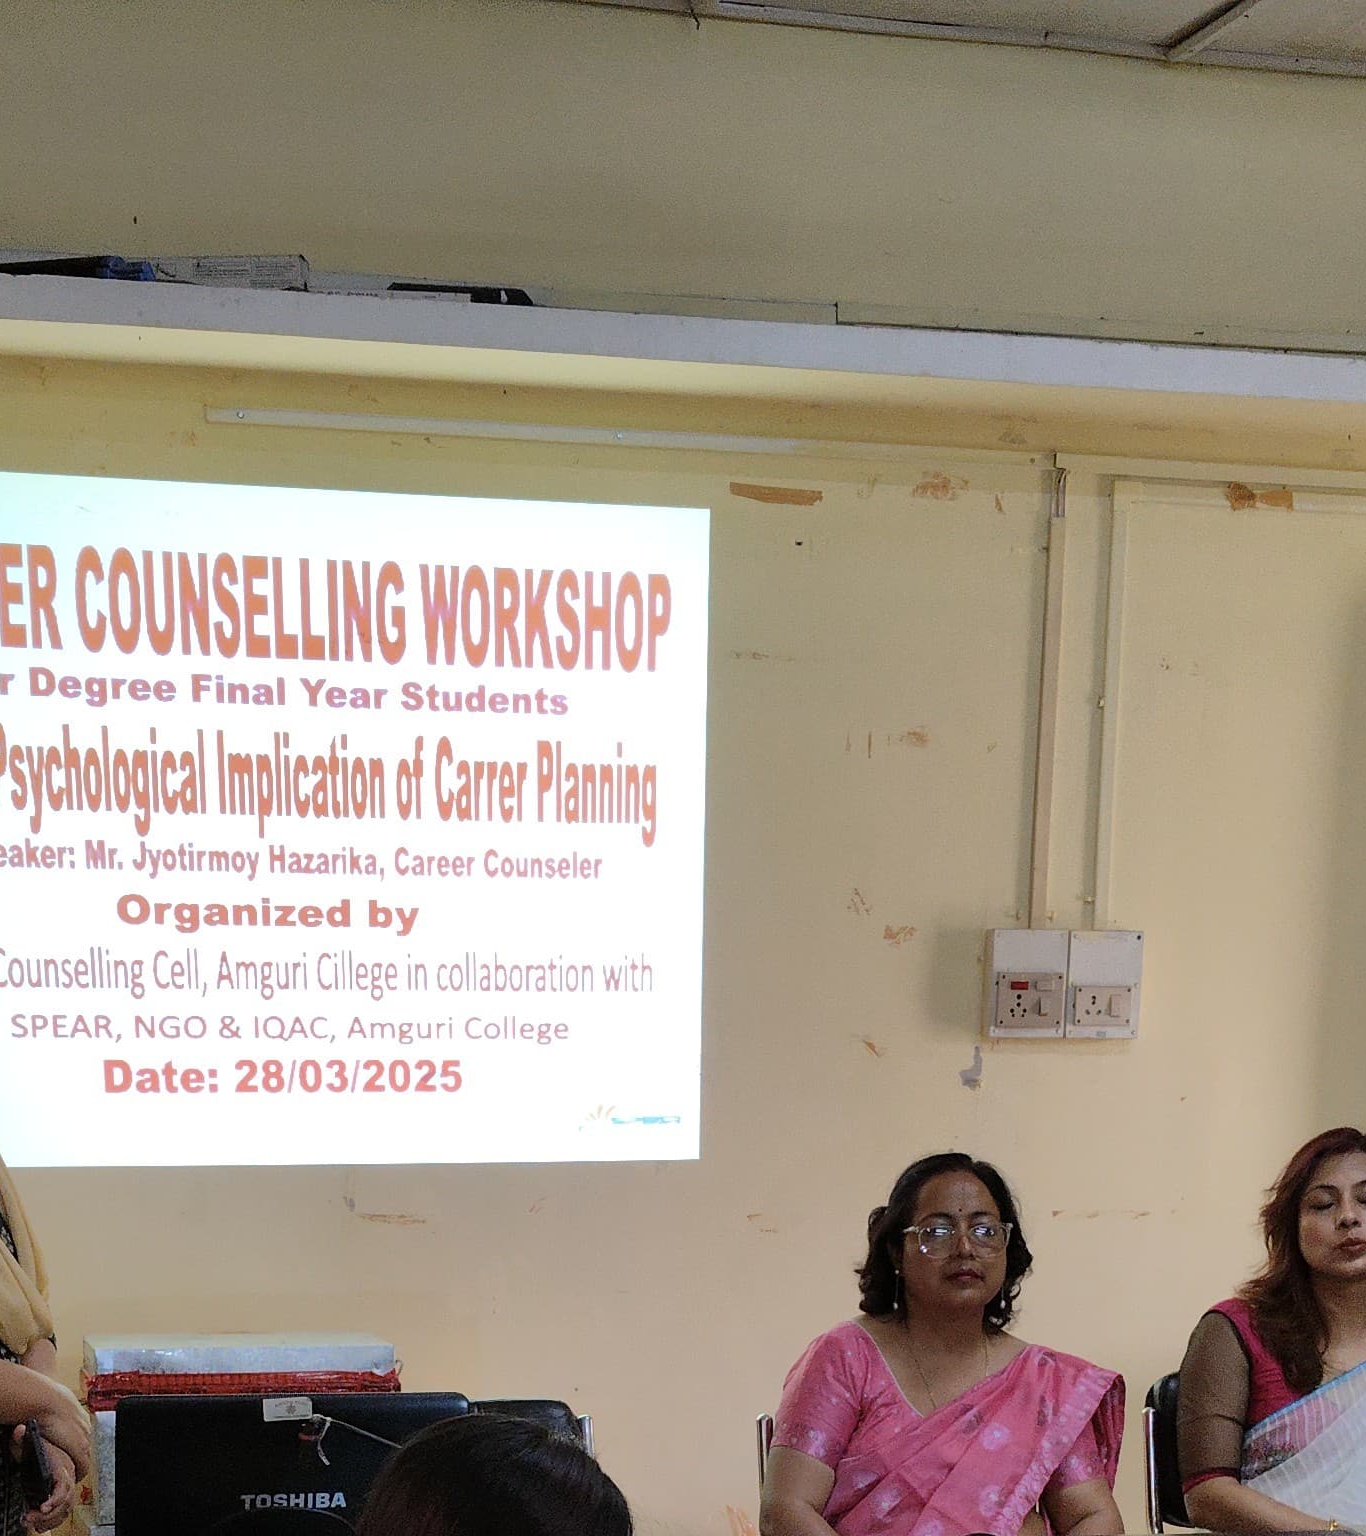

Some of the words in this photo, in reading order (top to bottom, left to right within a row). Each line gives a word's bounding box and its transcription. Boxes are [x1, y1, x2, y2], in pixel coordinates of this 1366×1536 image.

[76, 547, 407, 666] COUNSELLING
[419, 565, 672, 673] WORKSHOP
[29, 667, 177, 708] Degree
[193, 674, 286, 706] Final
[301, 679, 388, 710] Year
[402, 682, 569, 716] Students
[218, 730, 386, 838] Implication
[397, 737, 424, 821] of
[436, 736, 528, 824] Carrer
[539, 742, 657, 848] Planning
[86, 841, 124, 870] Mr.
[134, 842, 260, 882] Jyotirmoy
[270, 846, 385, 877] Hazarika,
[396, 848, 475, 877] Career
[485, 850, 602, 879] Counseler
[118, 895, 351, 934] Organized
[370, 901, 420, 937] by
[154, 949, 207, 998] Cell,
[218, 953, 308, 1001] Amguri
[319, 952, 398, 1002] Cillege
[408, 953, 428, 991] in
[438, 953, 594, 992] collaboration
[604, 953, 653, 993] with
[13, 1015, 122, 1043] SPEAR,
[136, 1017, 207, 1039] NGO
[220, 1017, 242, 1039] &
[256, 1017, 336, 1042] IQAC,
[349, 1018, 453, 1045] Amguri
[466, 1017, 569, 1045] College
[105, 1060, 219, 1094] Date:
[236, 1061, 463, 1094] 28/03/2025
[240, 1492, 347, 1510] TOSHIBA
